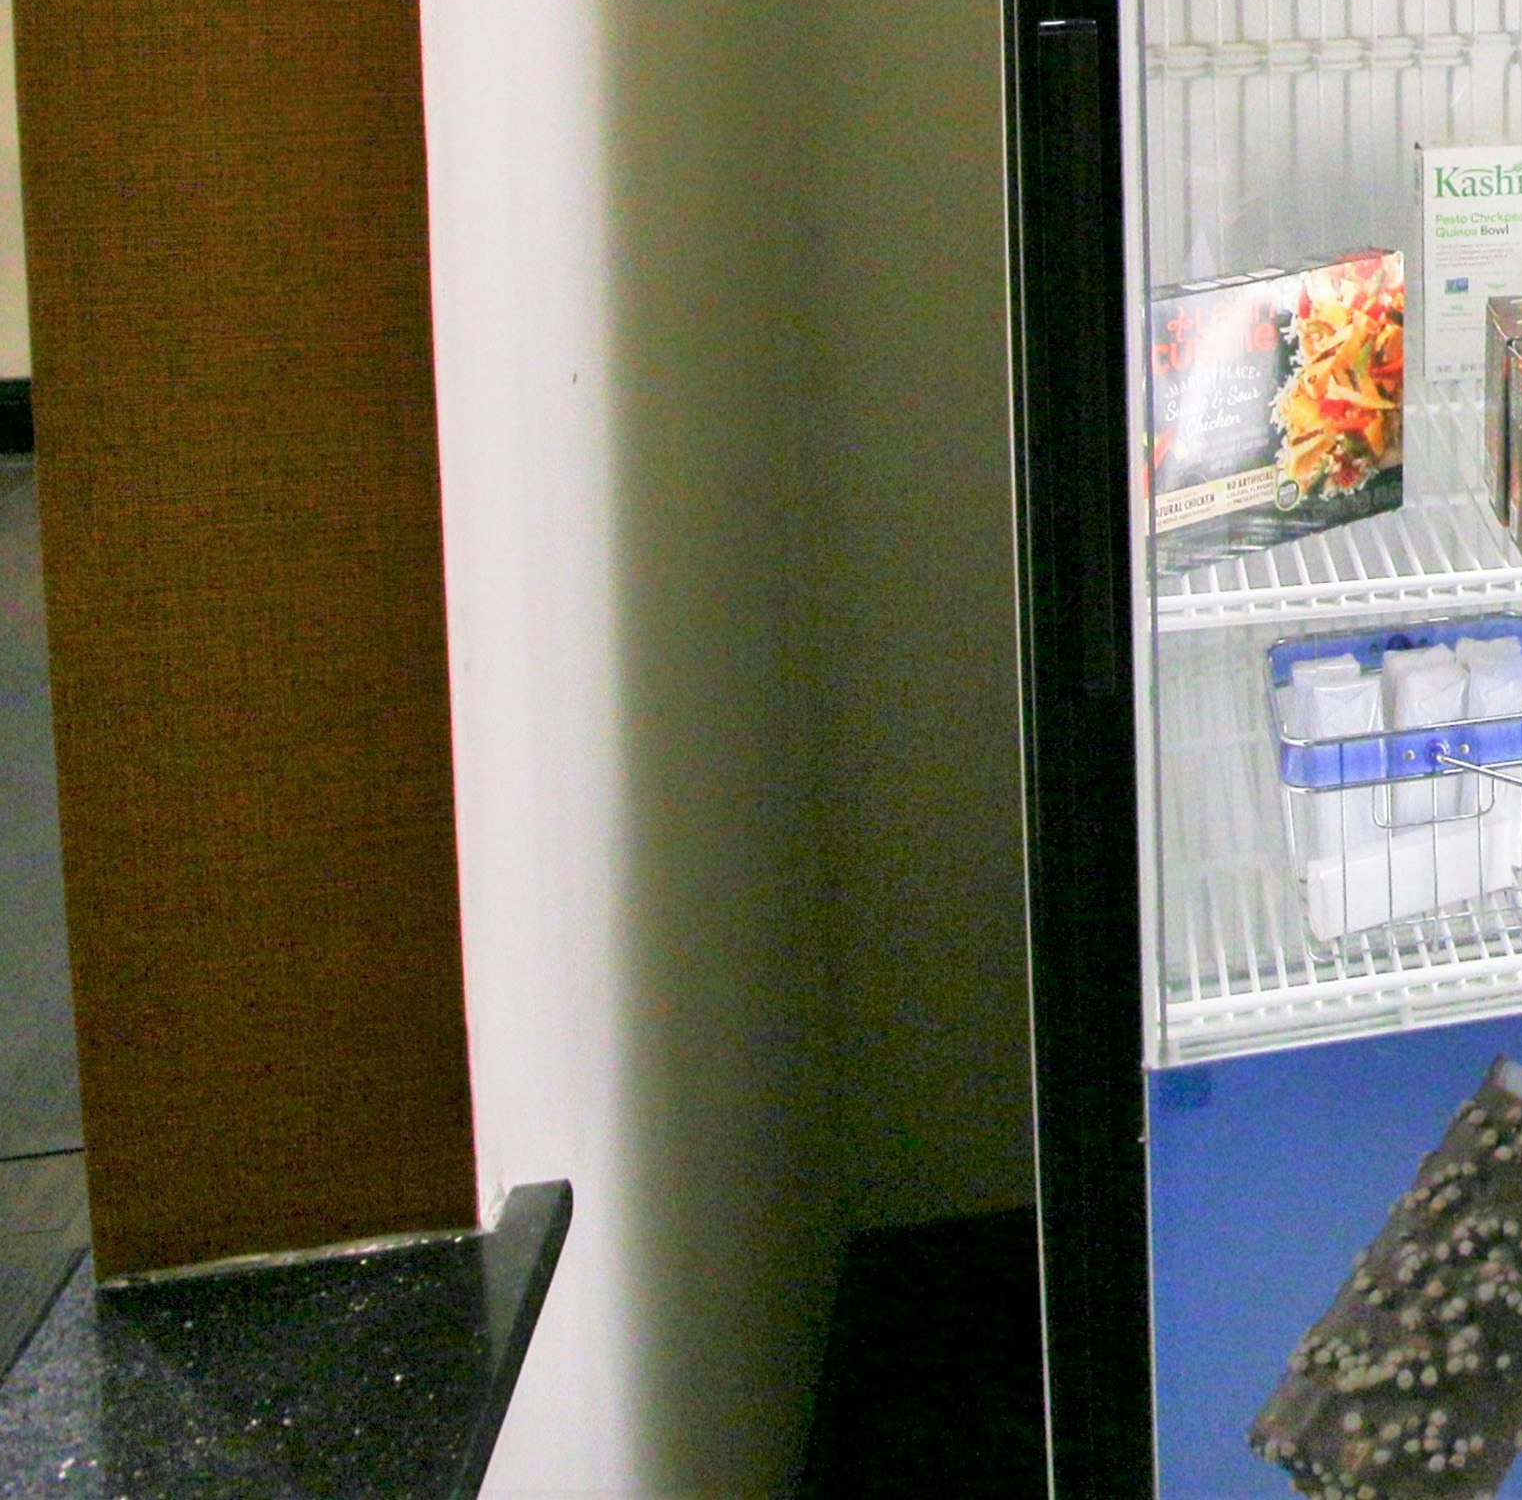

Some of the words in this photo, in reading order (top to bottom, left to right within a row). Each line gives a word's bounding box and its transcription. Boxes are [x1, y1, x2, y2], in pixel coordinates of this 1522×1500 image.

[1436, 214, 1468, 225] Pesto
[1480, 224, 1509, 236] Bowl
[1186, 412, 1241, 437] Chicken
